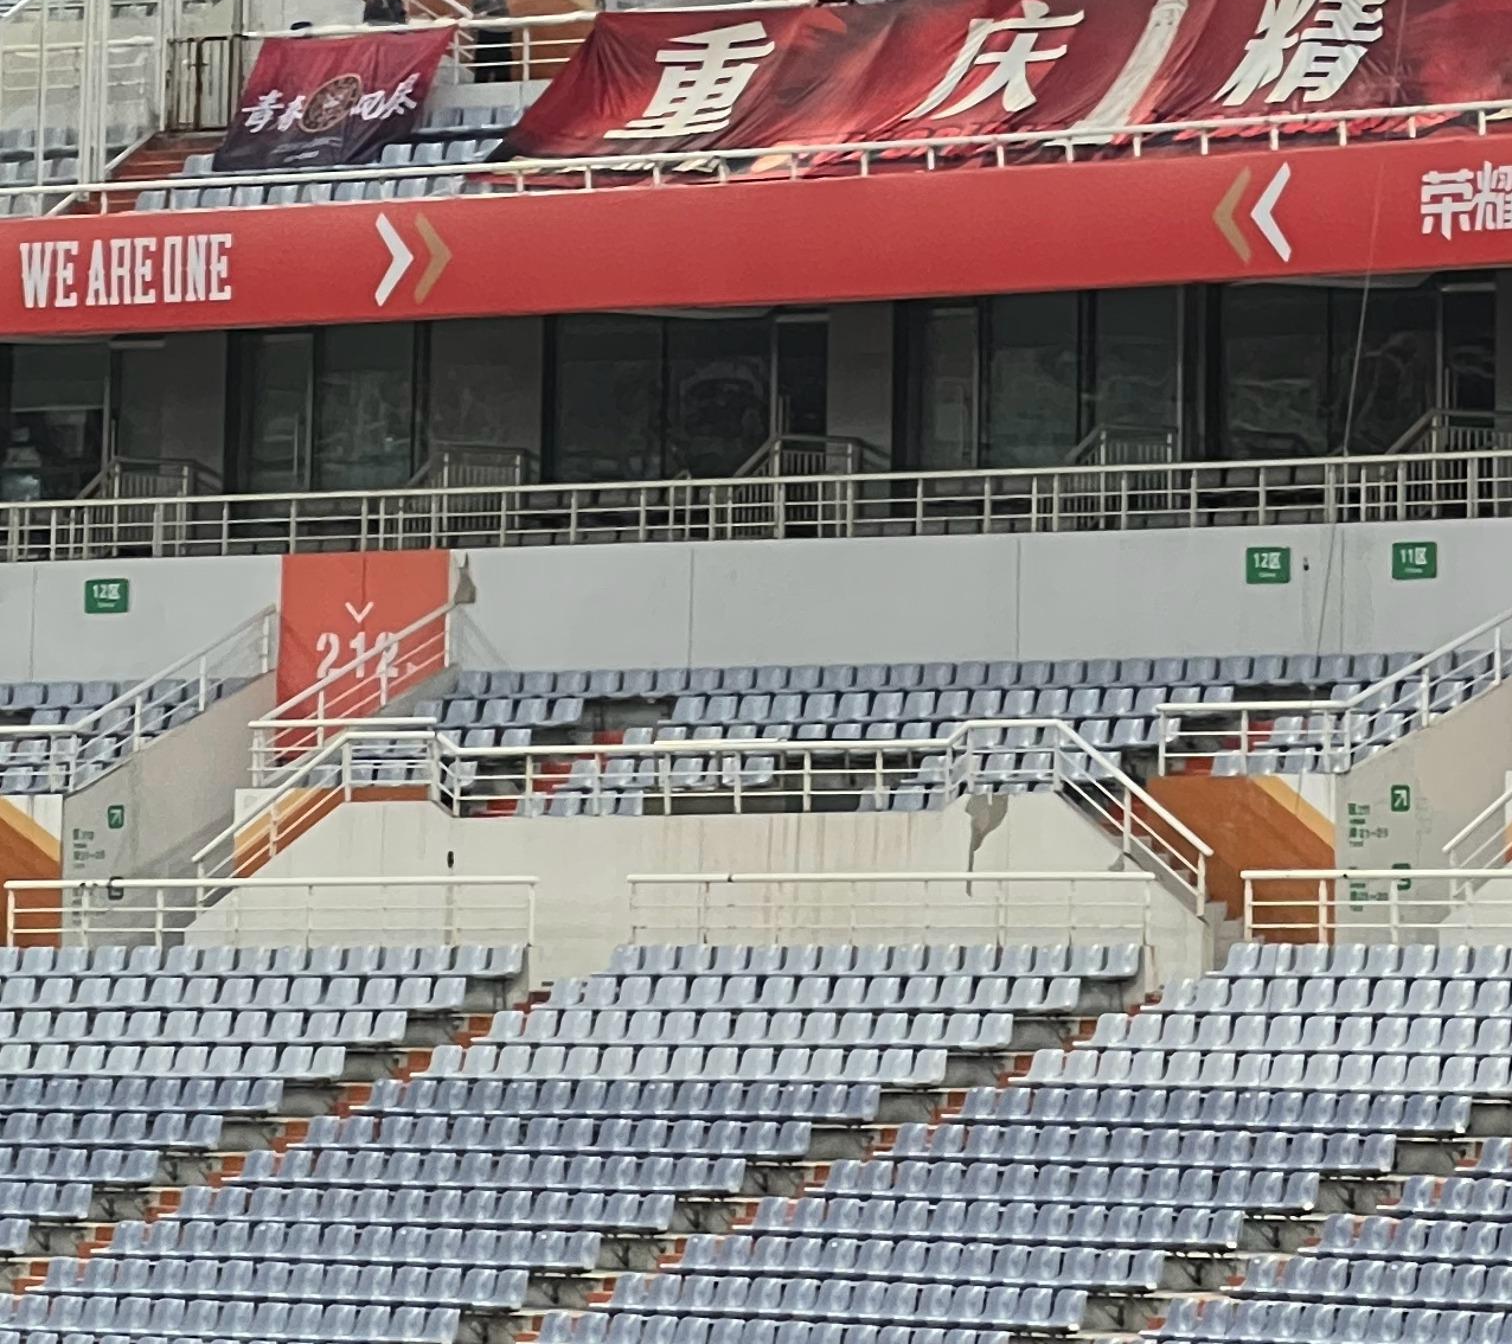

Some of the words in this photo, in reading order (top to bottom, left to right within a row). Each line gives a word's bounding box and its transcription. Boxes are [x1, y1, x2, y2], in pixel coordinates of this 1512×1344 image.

[20, 241, 79, 308] WE
[86, 237, 157, 306] ARE
[163, 233, 232, 302] ONE
